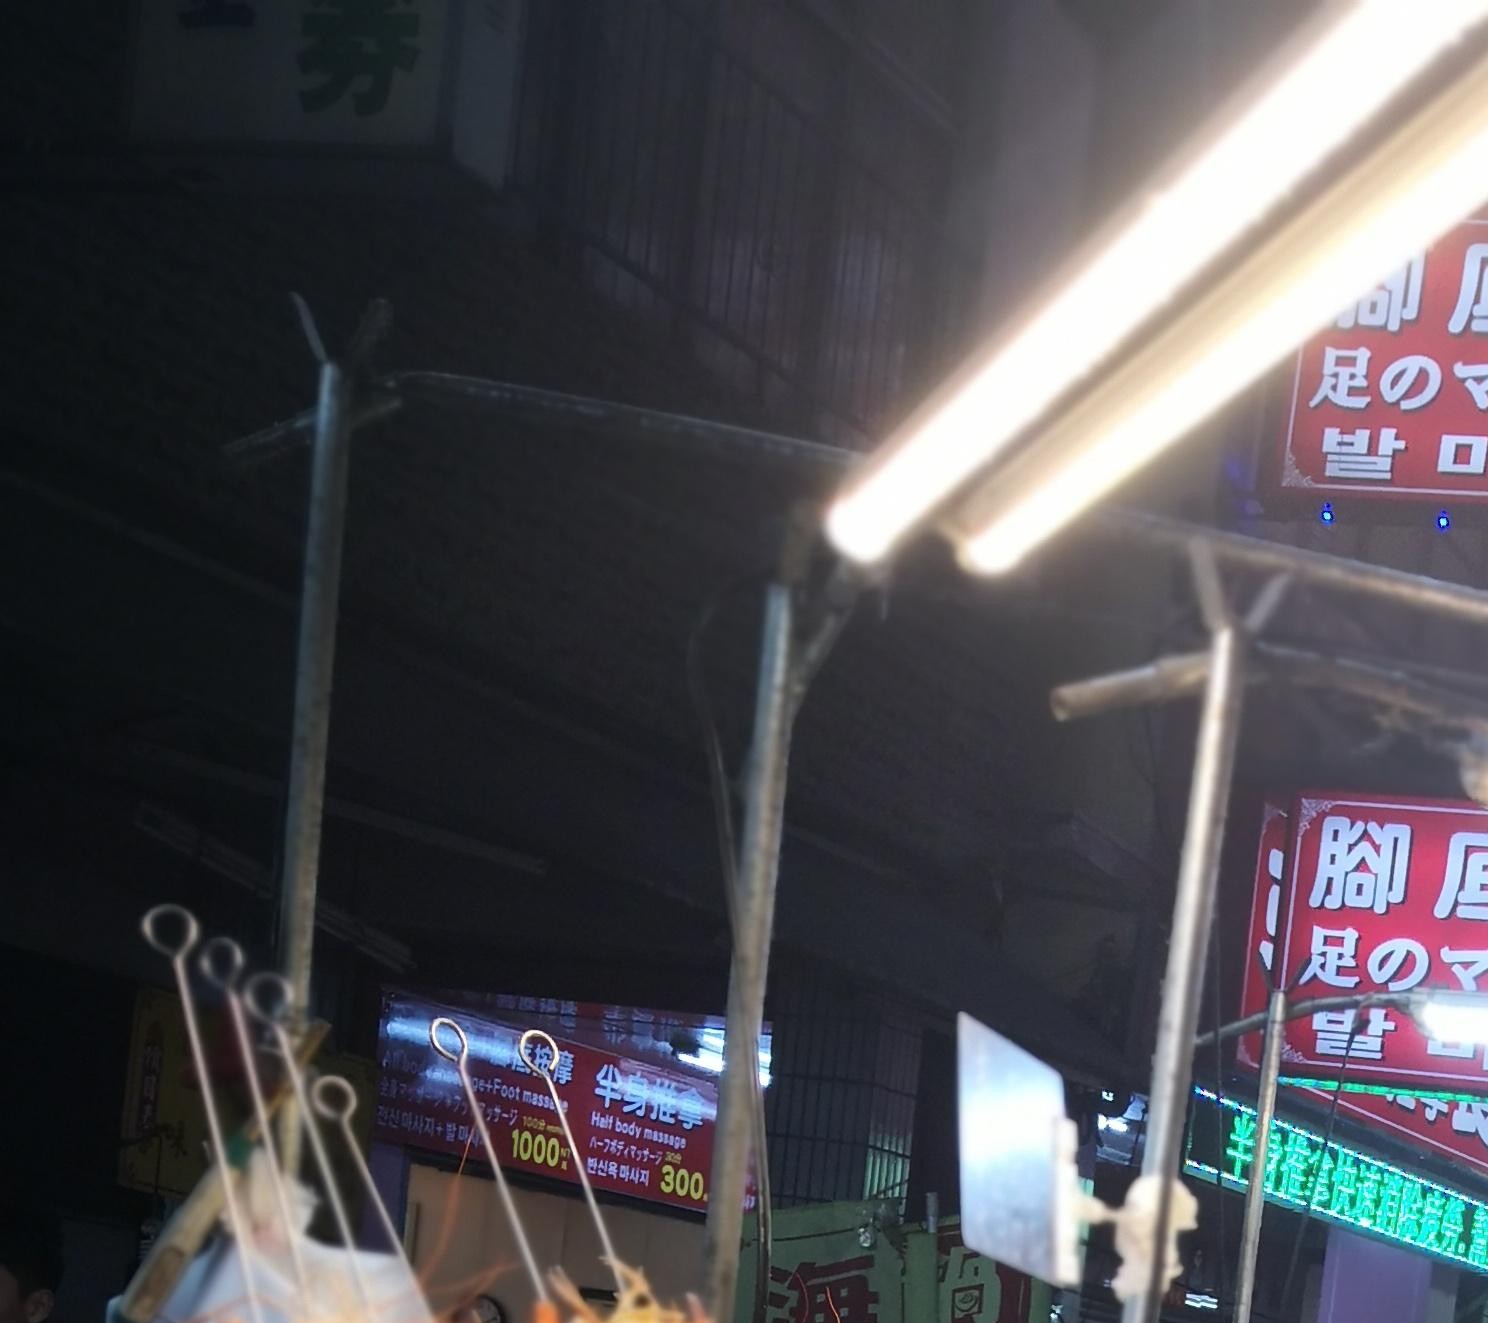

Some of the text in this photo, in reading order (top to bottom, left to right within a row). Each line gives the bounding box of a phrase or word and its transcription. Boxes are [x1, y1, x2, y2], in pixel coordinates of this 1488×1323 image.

[512, 1128, 560, 1167] 1000
[590, 1111, 614, 1130] Half
[615, 1118, 641, 1139] body
[643, 1126, 687, 1150] massage
[659, 1164, 705, 1201] 300
